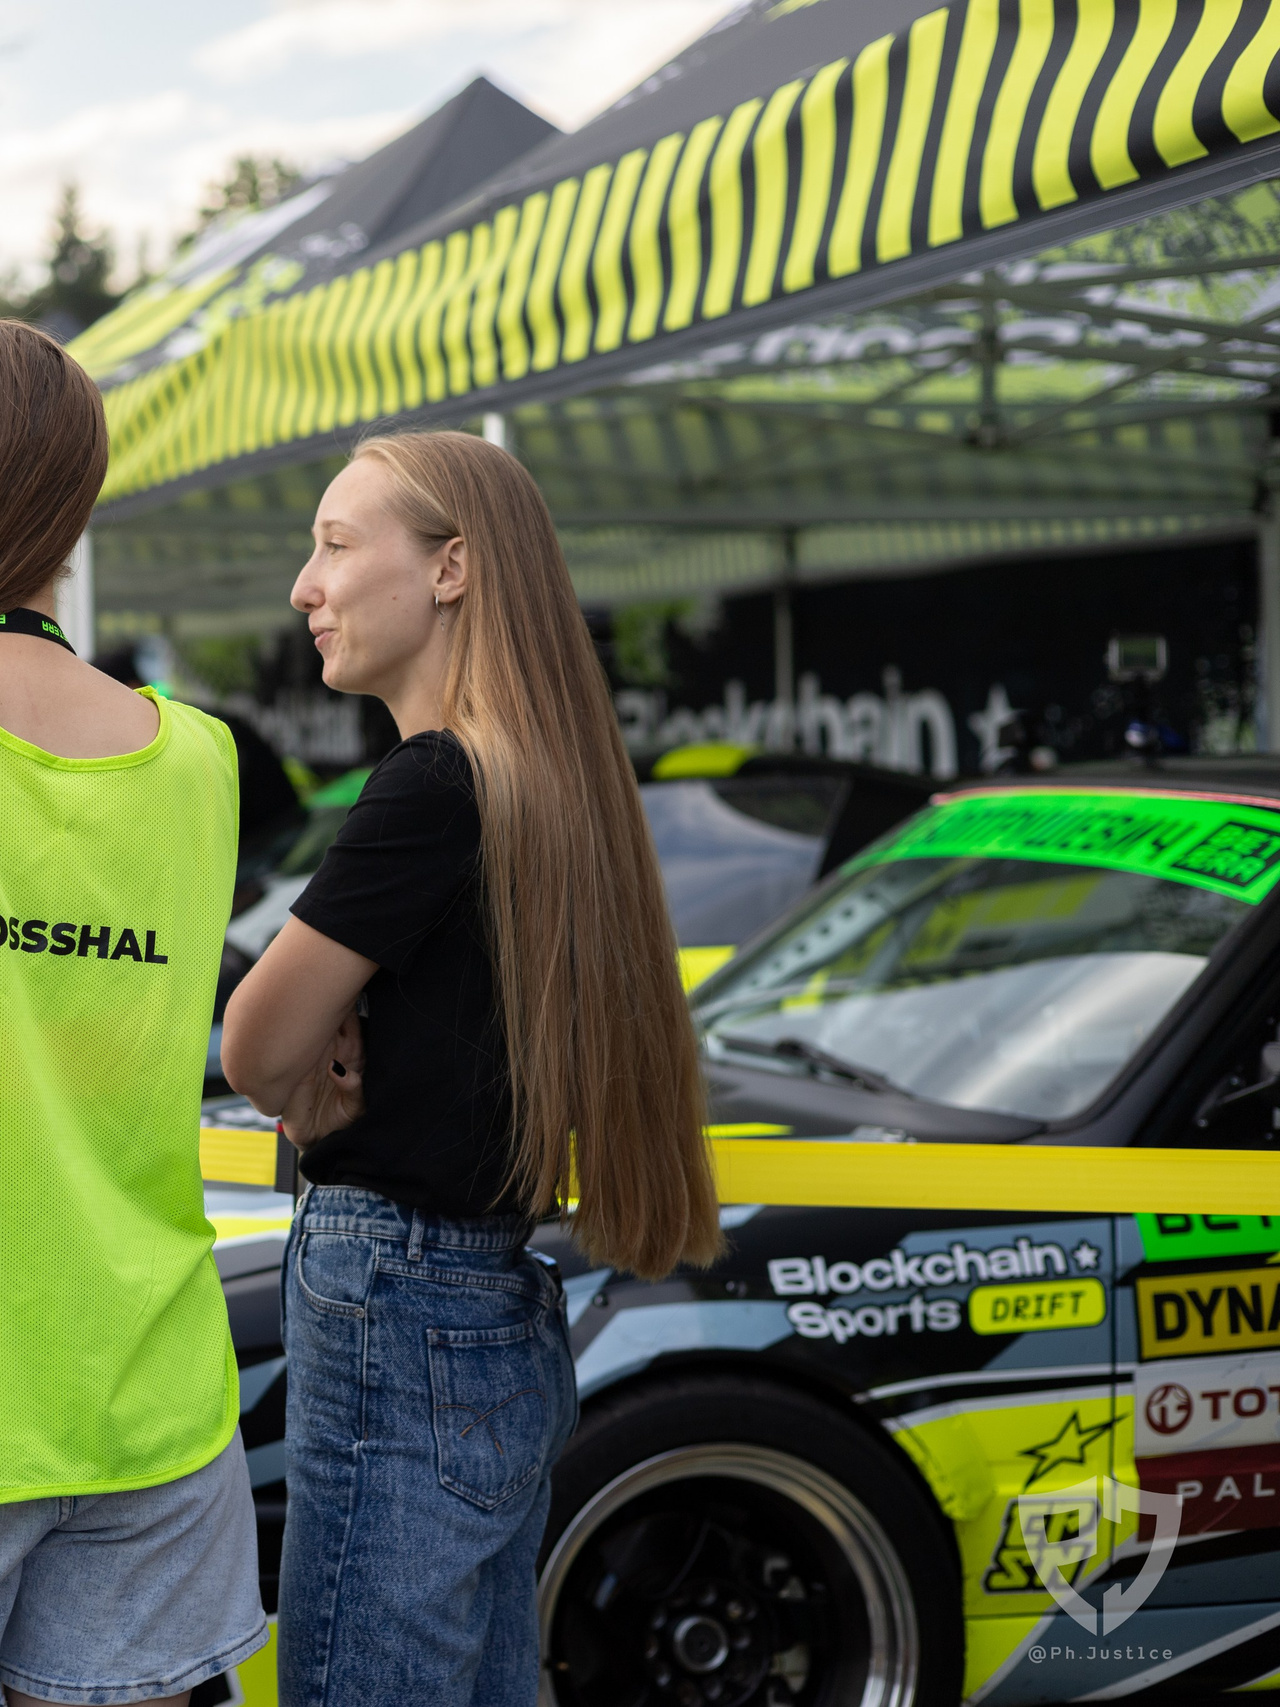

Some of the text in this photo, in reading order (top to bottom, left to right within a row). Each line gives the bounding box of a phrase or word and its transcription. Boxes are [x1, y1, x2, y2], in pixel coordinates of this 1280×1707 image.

[767, 1237, 1068, 1297] Blockchain
[786, 1289, 1088, 1345] Sports DRIFT
[1175, 1472, 1276, 1507] PAL
